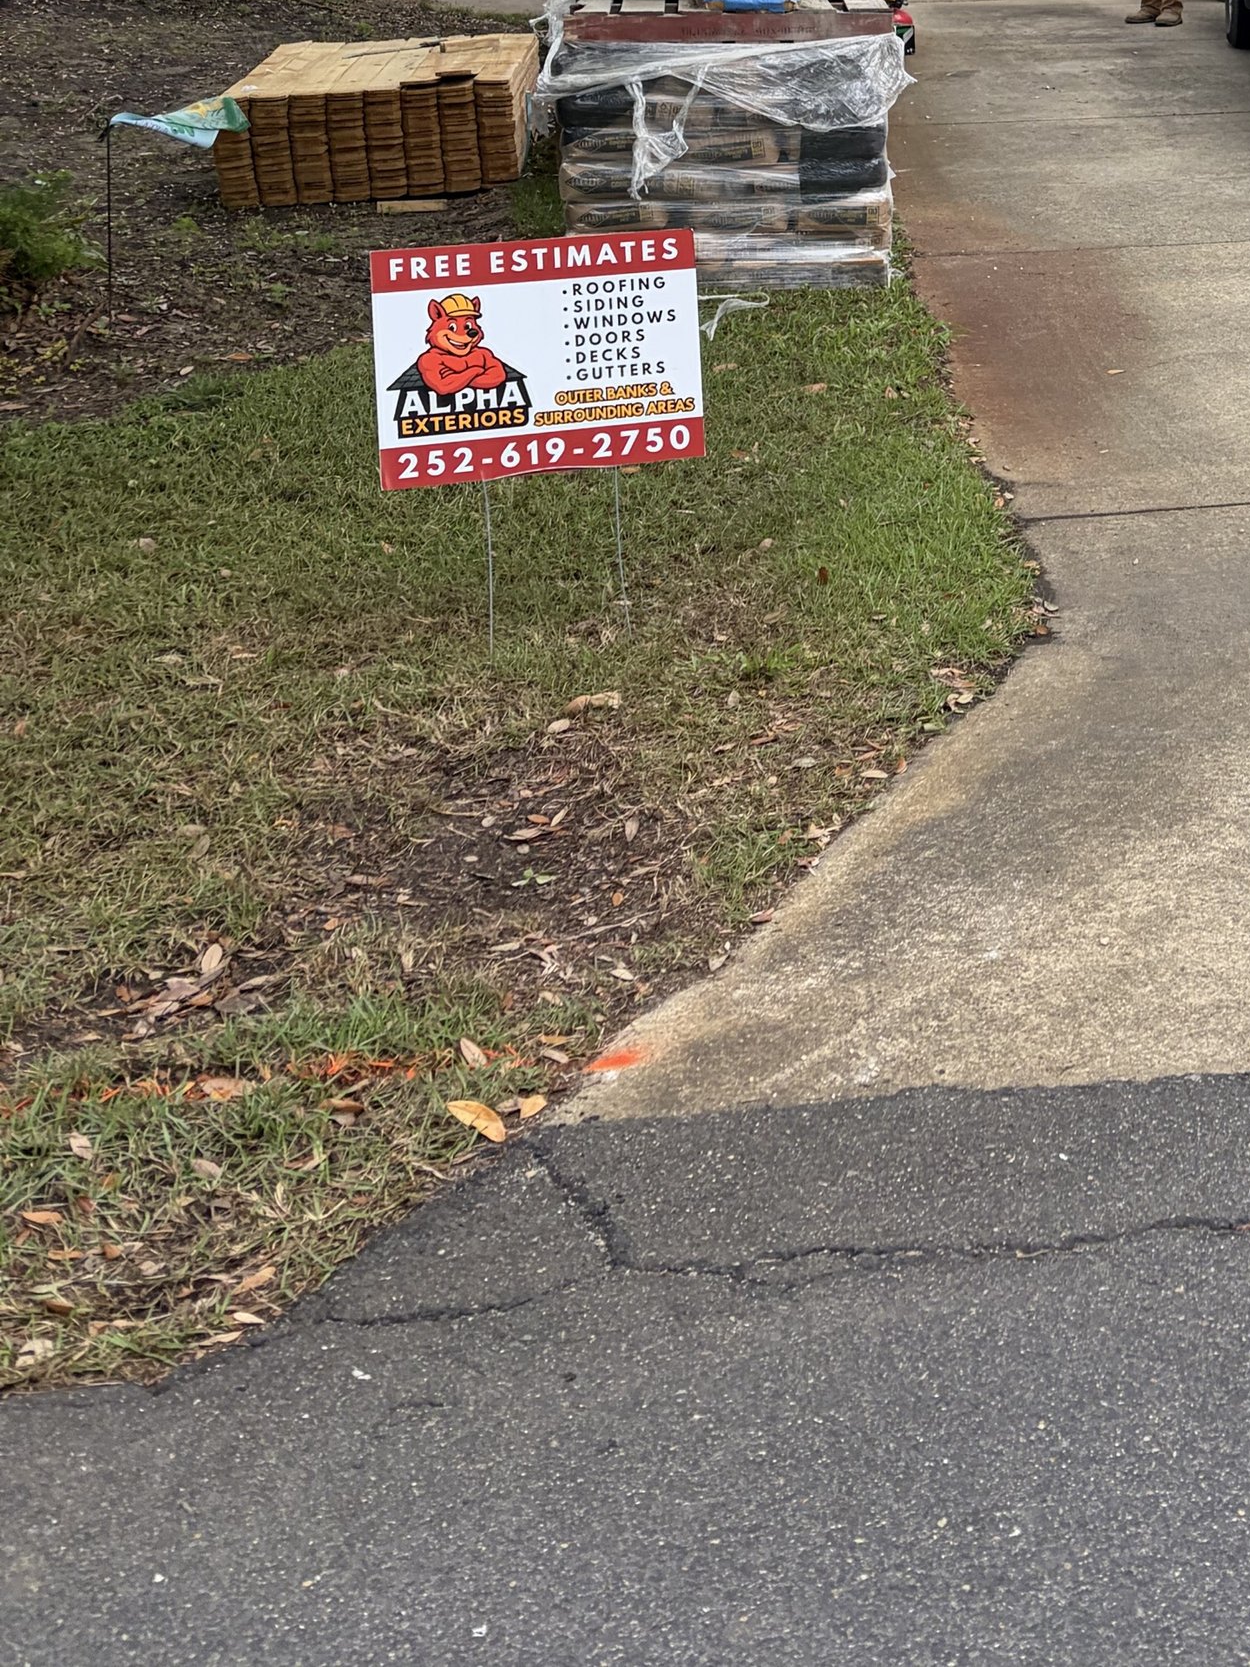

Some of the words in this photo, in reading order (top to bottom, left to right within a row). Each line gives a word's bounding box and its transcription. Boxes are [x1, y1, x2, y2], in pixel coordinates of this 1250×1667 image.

[389, 254, 471, 281] FREE
[490, 238, 679, 274] ESTIMATES
[572, 276, 666, 296] ROOFING
[574, 296, 644, 313] SIDING
[574, 309, 676, 330] WINDOWS
[575, 329, 646, 347] DOORS
[576, 346, 641, 364] DECKS
[576, 362, 666, 382] GUTTERS
[400, 381, 528, 417] ALPHA
[555, 388, 604, 406] OUTER
[605, 384, 657, 402] BANKS
[659, 382, 673, 396] &
[402, 408, 525, 436] EXTERIORS
[534, 403, 644, 426] SURROUNDING
[646, 398, 695, 416] AREAS
[398, 424, 690, 480] 252-619-2750
